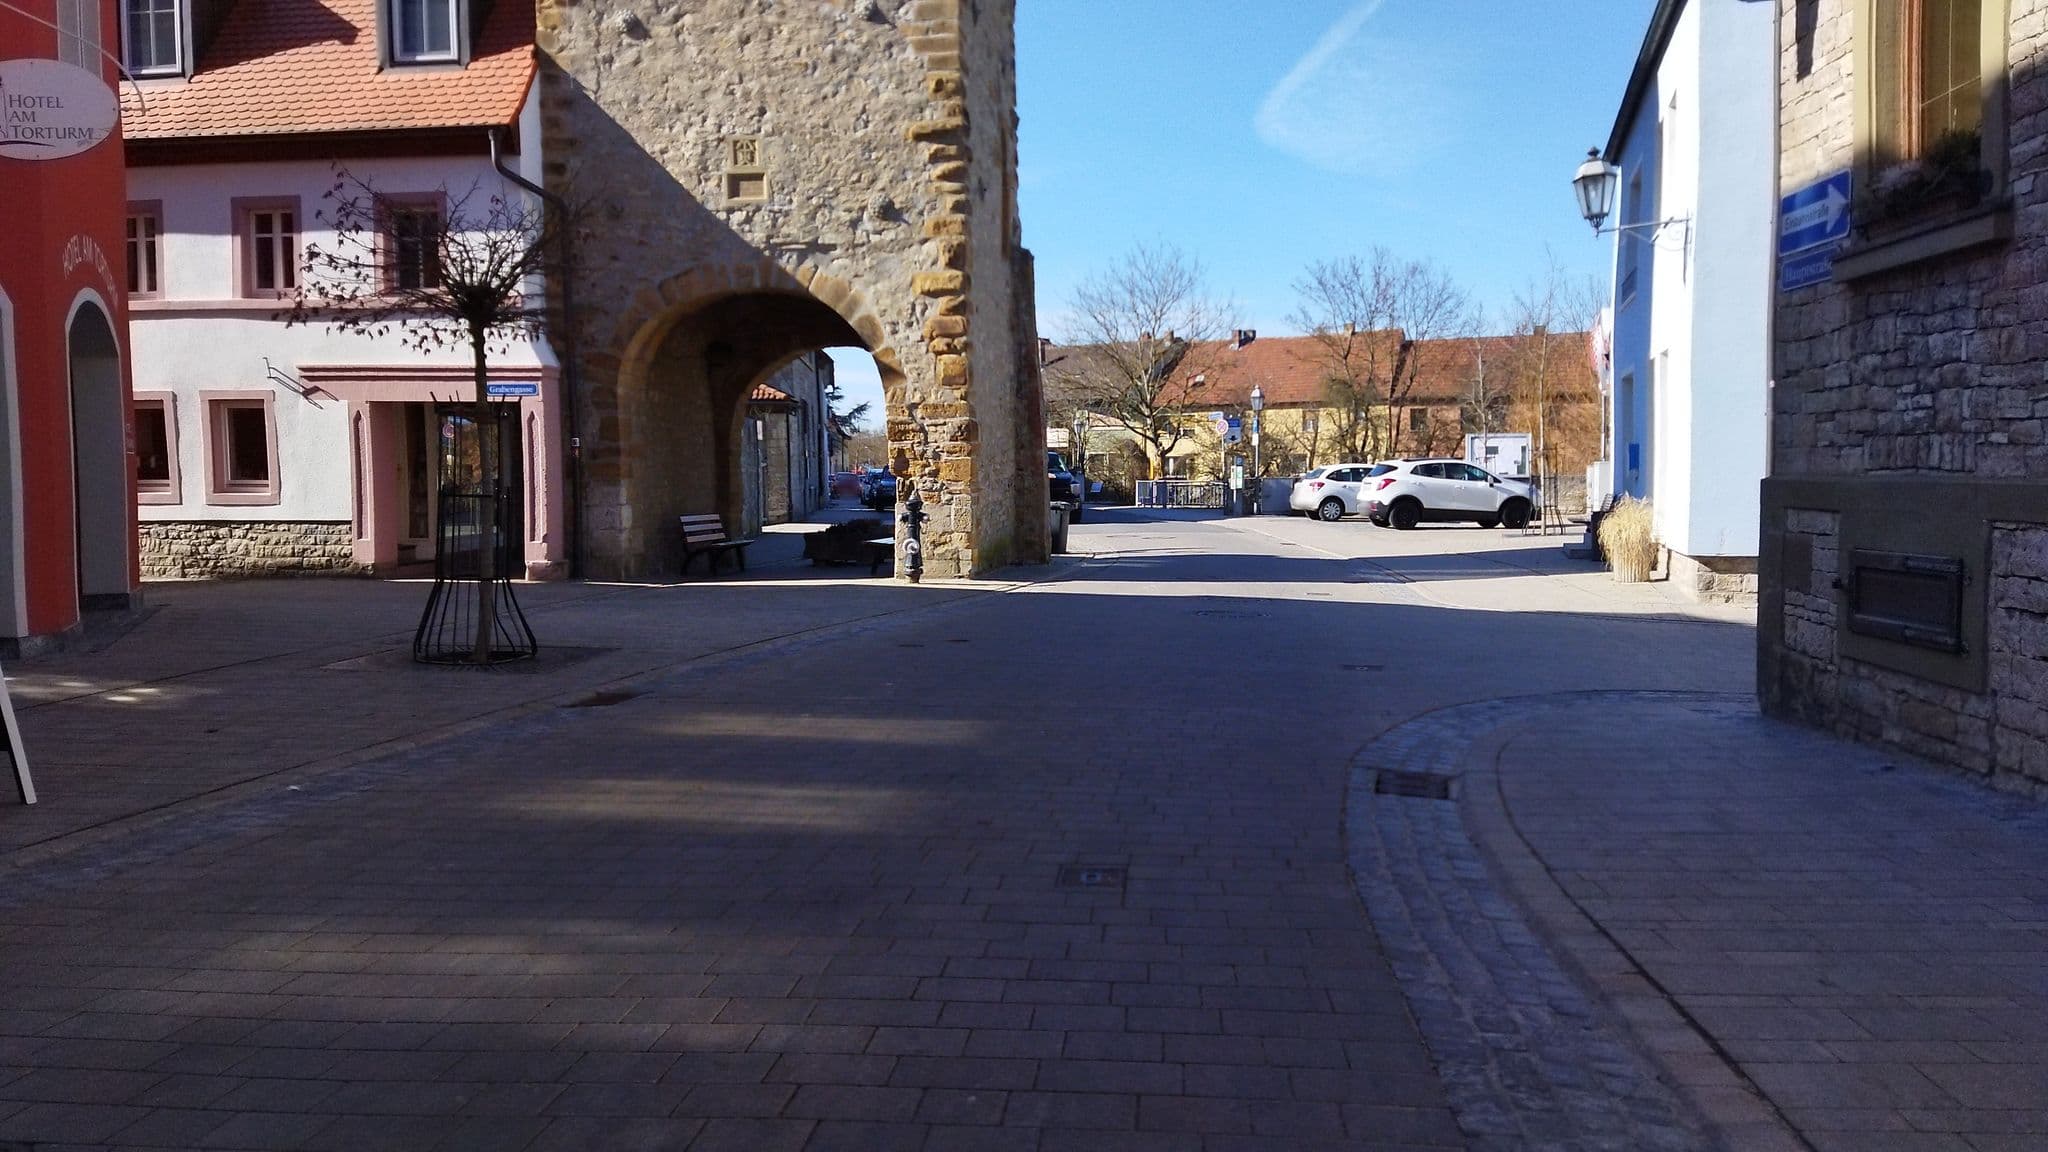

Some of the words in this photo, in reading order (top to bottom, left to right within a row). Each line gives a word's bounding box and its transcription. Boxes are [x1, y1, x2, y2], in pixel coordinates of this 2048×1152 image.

[9, 94, 64, 109] HOTEL
[9, 110, 36, 123] AM
[9, 124, 94, 140] TORTURM
[489, 385, 533, 394] Grabengasse
